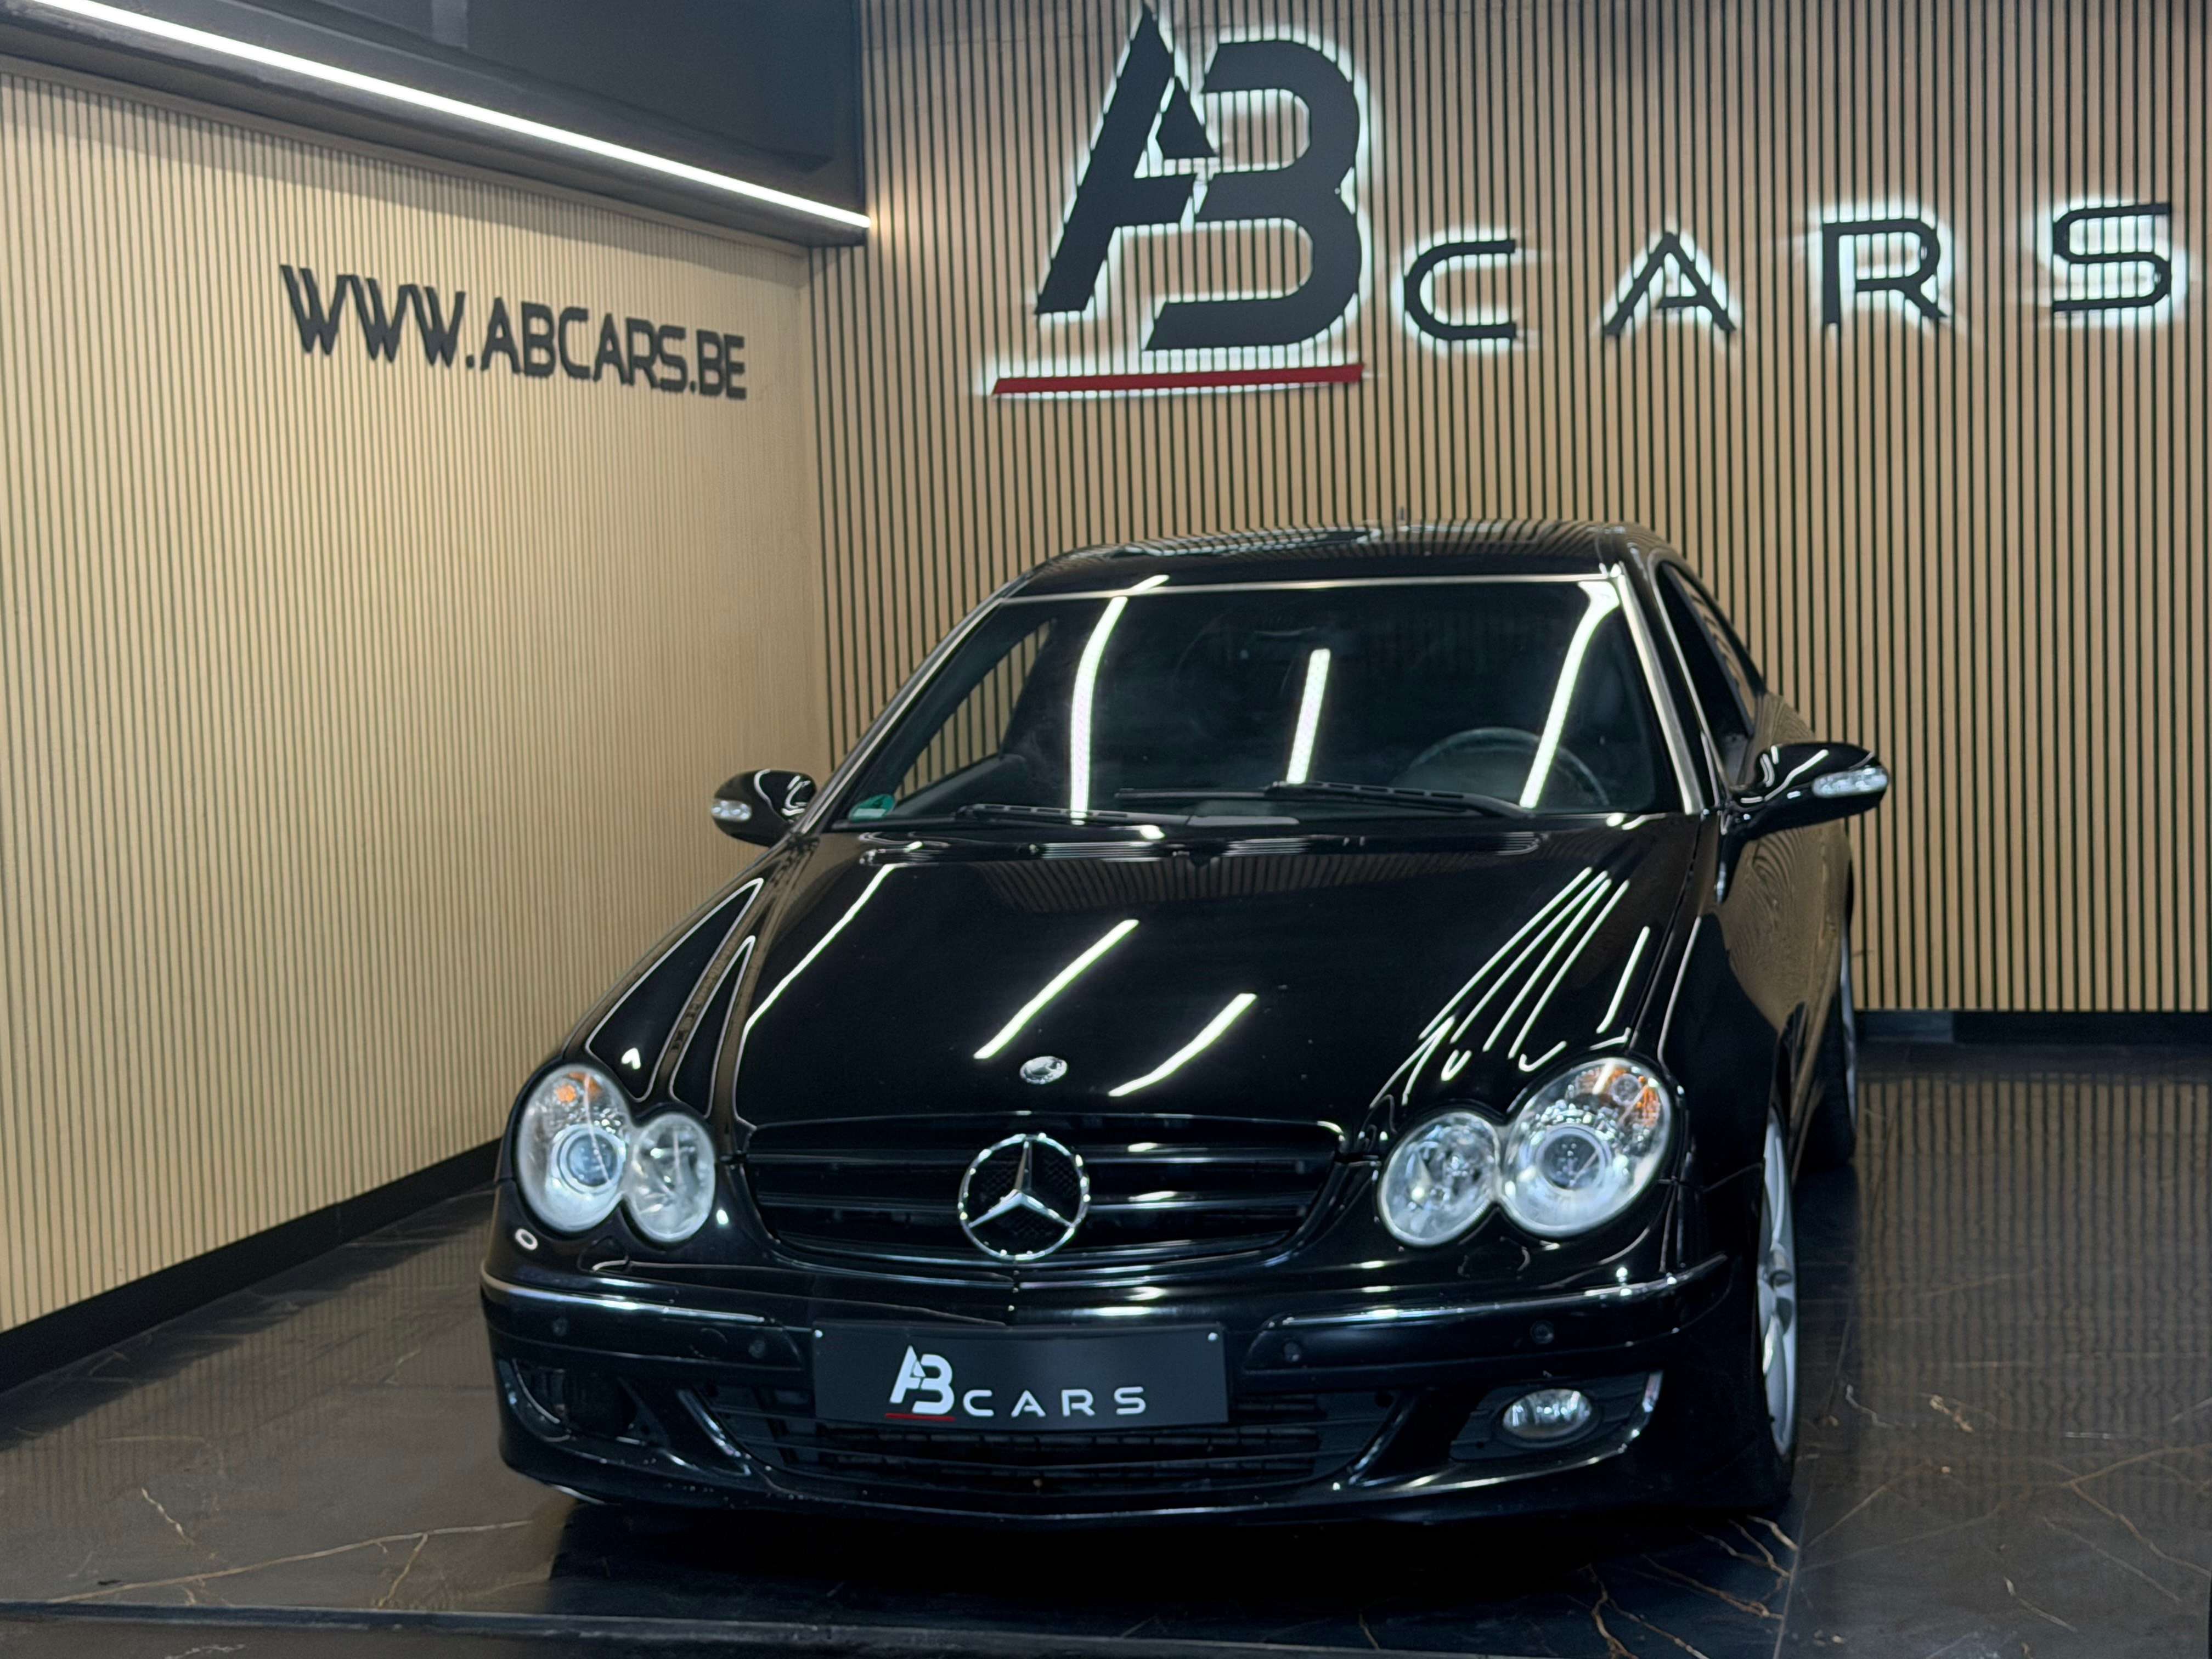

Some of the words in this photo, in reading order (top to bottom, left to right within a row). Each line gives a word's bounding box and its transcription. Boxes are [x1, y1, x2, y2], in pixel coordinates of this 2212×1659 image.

[1035, 2, 1362, 352] AB
[1404, 201, 2172, 341] CARS
[280, 264, 747, 399] WWW.ABCARS.BE
[889, 1346, 955, 1415] AB
[963, 1387, 1147, 1418] CARS
